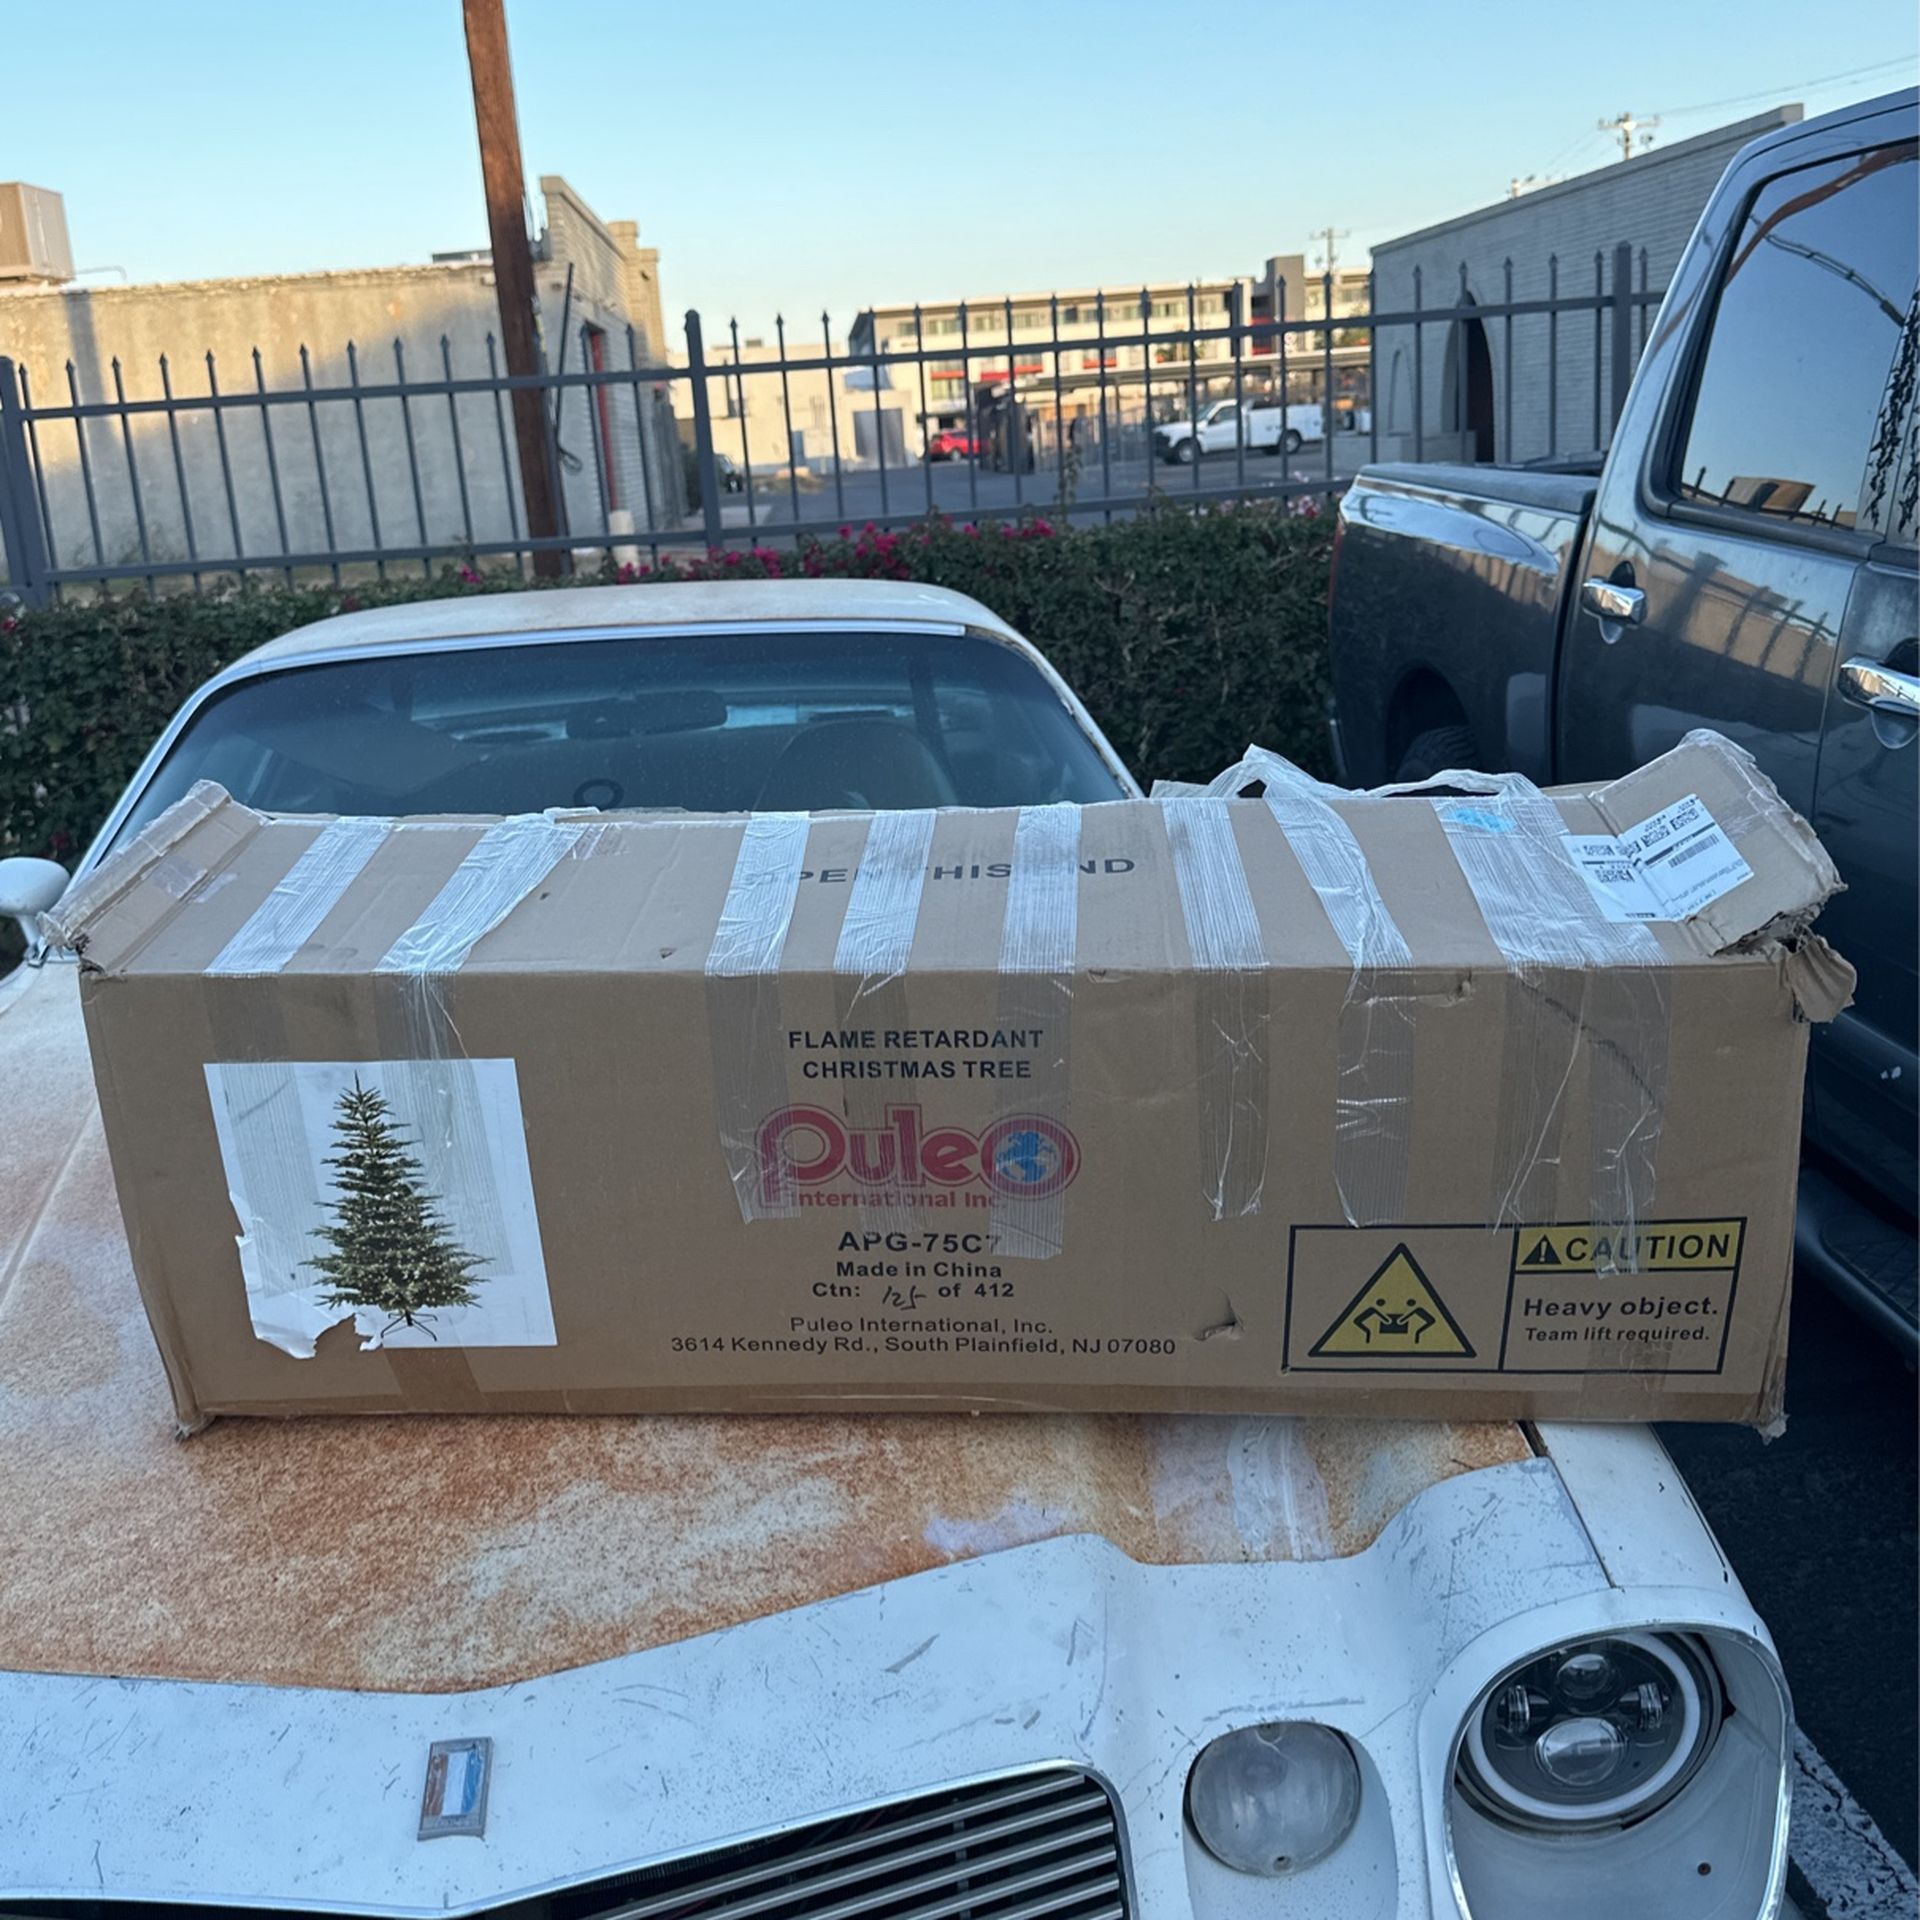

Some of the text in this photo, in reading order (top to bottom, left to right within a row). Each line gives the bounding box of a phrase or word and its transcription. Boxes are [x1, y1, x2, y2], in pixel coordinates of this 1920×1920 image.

[788, 1030, 1044, 1050] FLAME RETARDANT
[802, 1060, 1032, 1079] CHRISTMAS TREE
[1565, 1232, 1731, 1263] CAUTION
[836, 1261, 1002, 1278] Made in China
[812, 1281, 860, 1298] Ctn:
[937, 1281, 962, 1298] of
[974, 1282, 1014, 1298] 412
[1523, 1296, 1719, 1320] Heavy object.
[790, 1316, 1053, 1336] Puleo International, Inc.
[1525, 1325, 1710, 1346] Team lift required.
[671, 1336, 1176, 1356] 3614 Kennedy Rd., South Plainfield, NJ 07080
